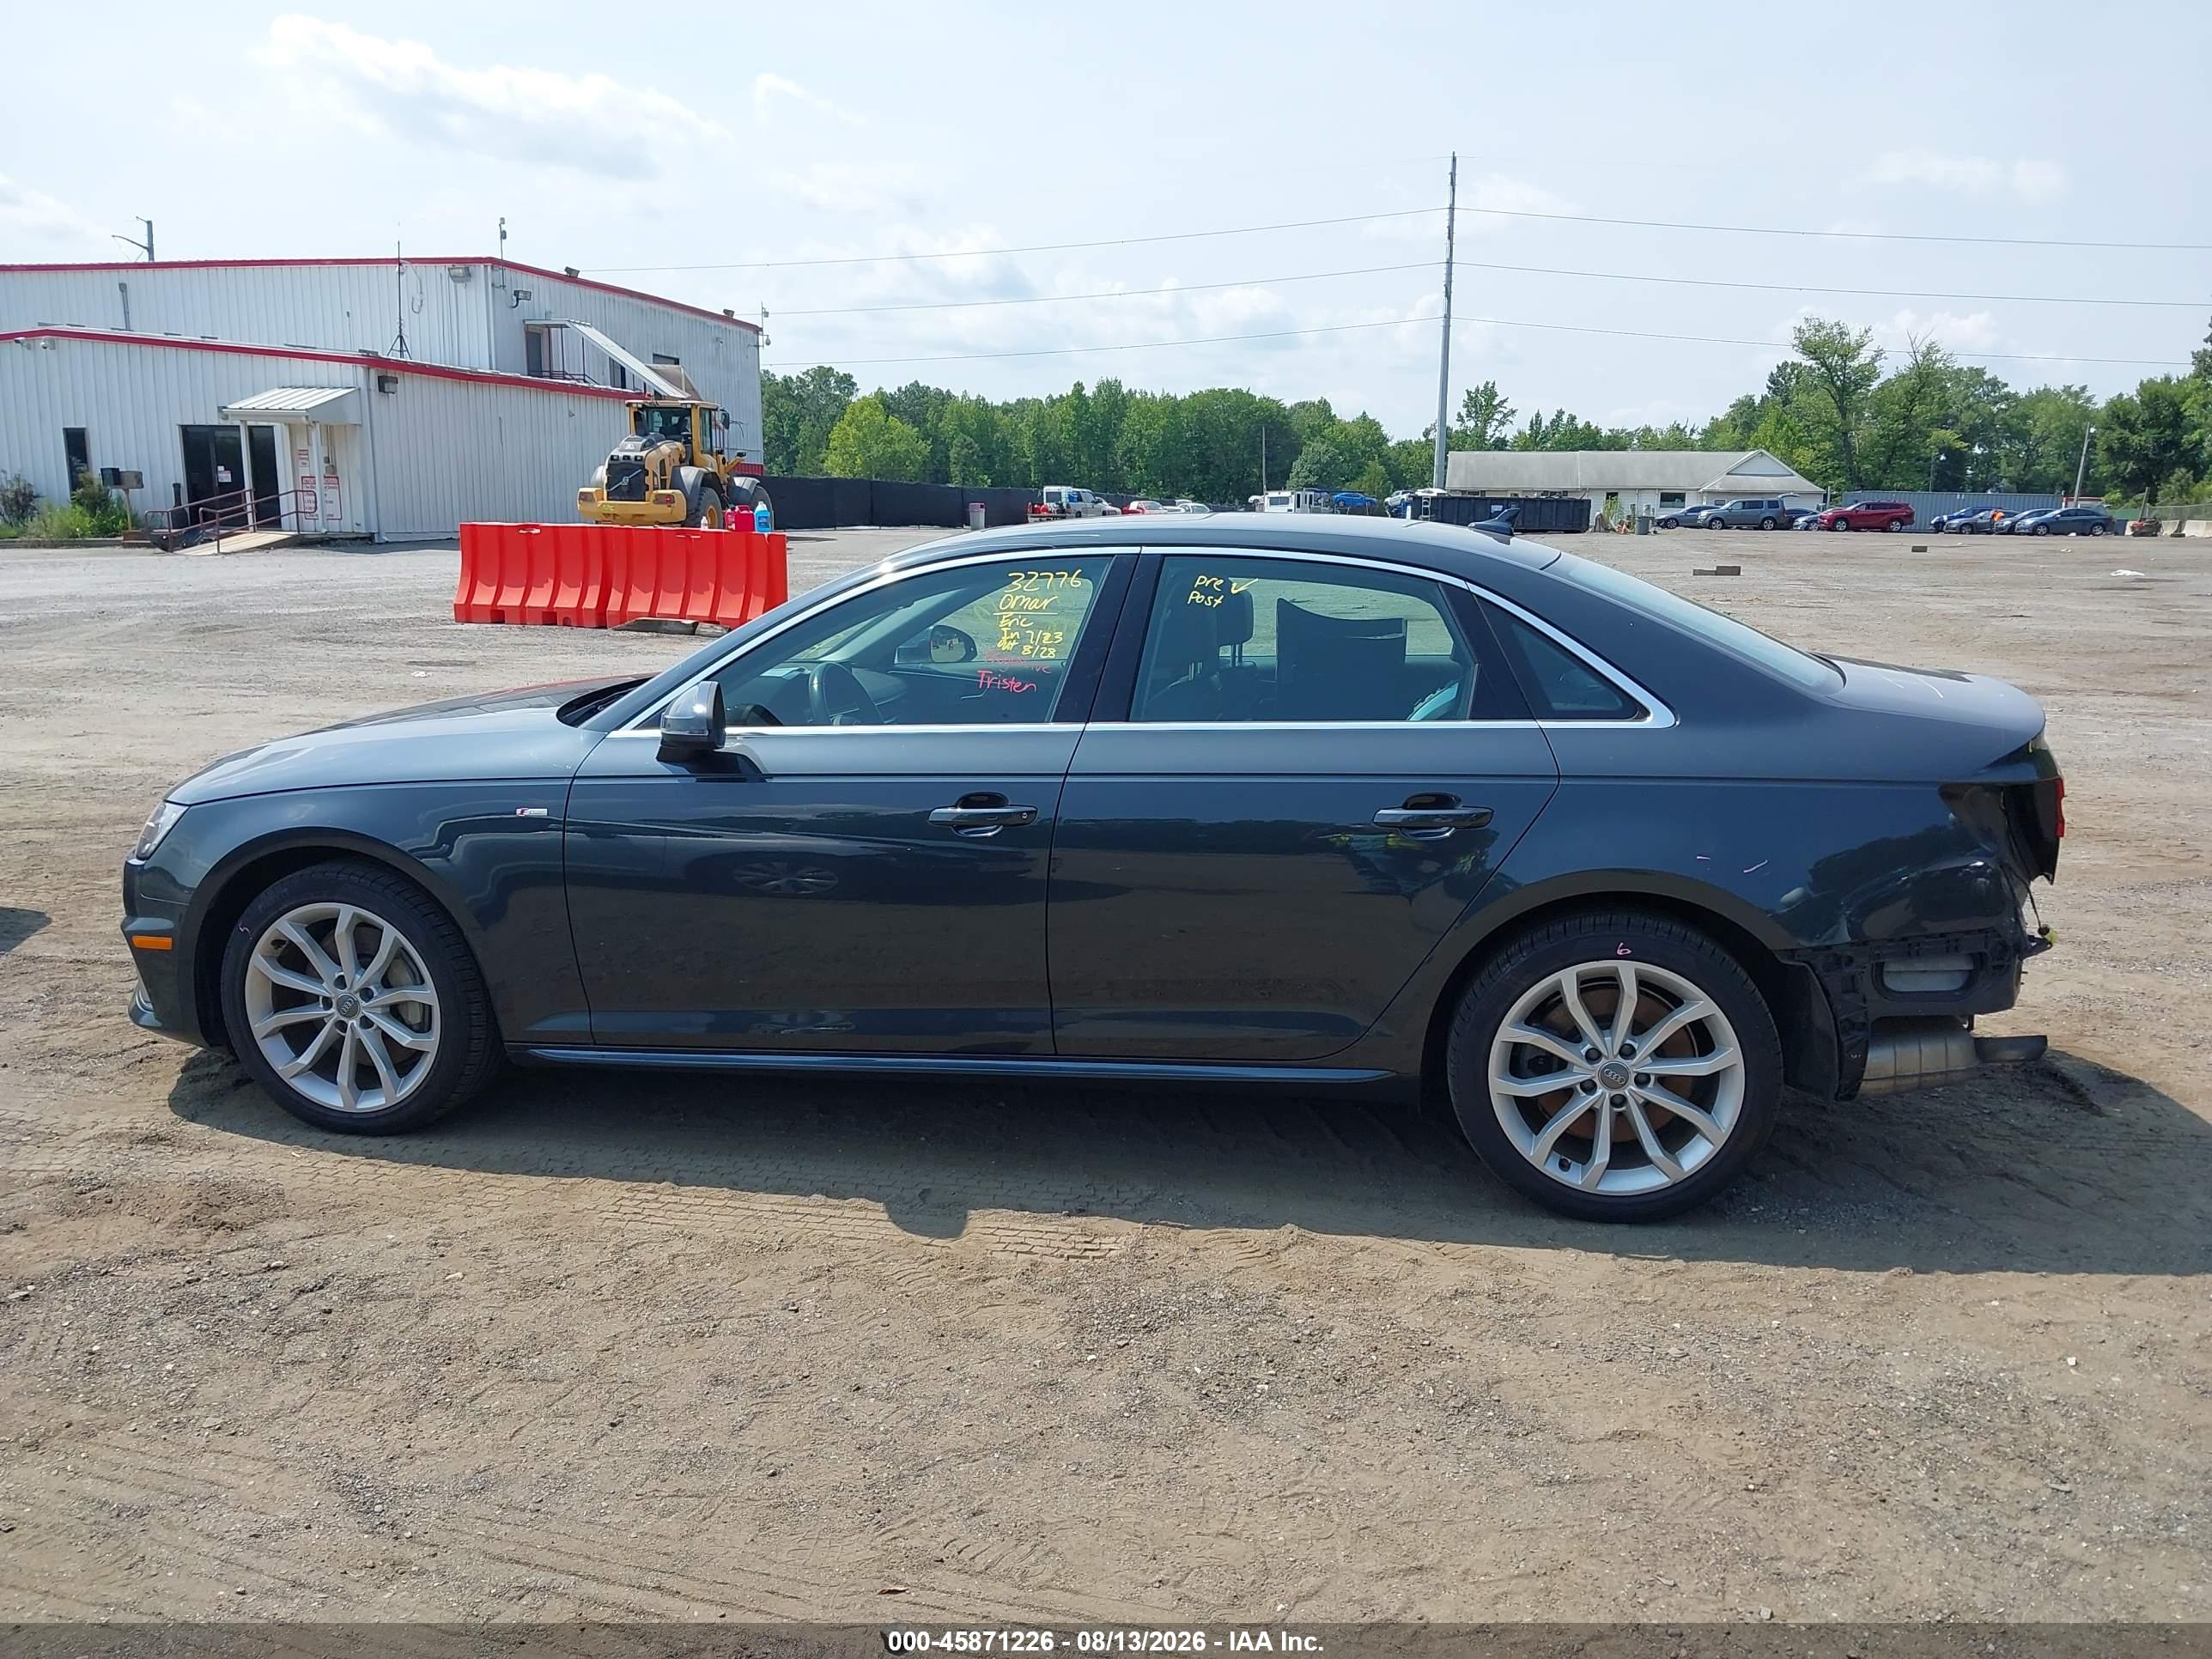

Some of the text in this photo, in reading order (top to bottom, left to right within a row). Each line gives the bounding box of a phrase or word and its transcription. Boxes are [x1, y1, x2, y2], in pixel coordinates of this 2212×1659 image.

[1004, 569, 1082, 592] 32776
[999, 594, 1058, 610] Omar
[1187, 591, 1224, 608] Post
[999, 612, 1034, 627] Eric
[1000, 628, 1020, 640] In
[1021, 645, 1056, 659] 8/28
[977, 670, 1037, 693] Tristen
[1616, 942, 1632, 956] 6
